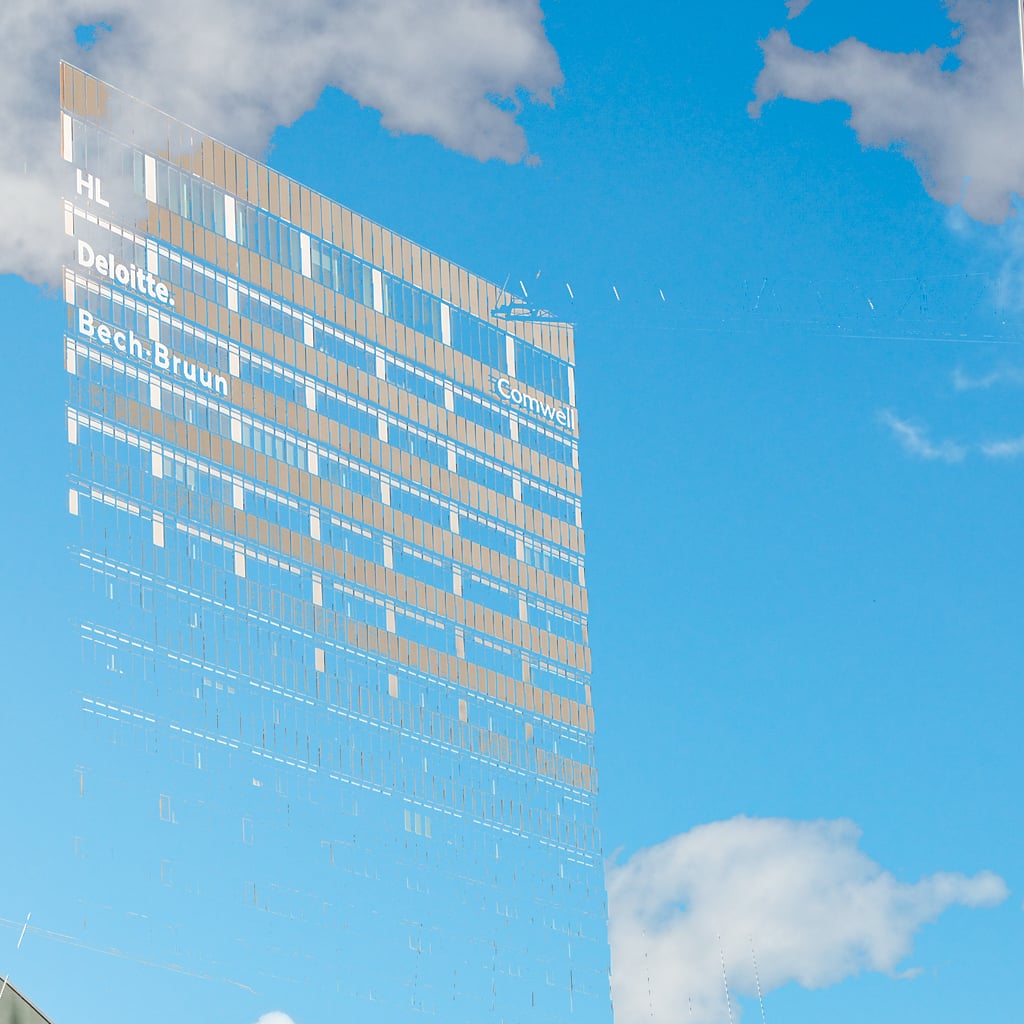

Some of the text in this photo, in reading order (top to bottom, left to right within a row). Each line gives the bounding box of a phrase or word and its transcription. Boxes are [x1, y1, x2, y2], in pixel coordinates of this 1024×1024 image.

[76, 168, 110, 208] HL
[77, 238, 176, 306] Deloitte.
[497, 378, 576, 431] Comwell
